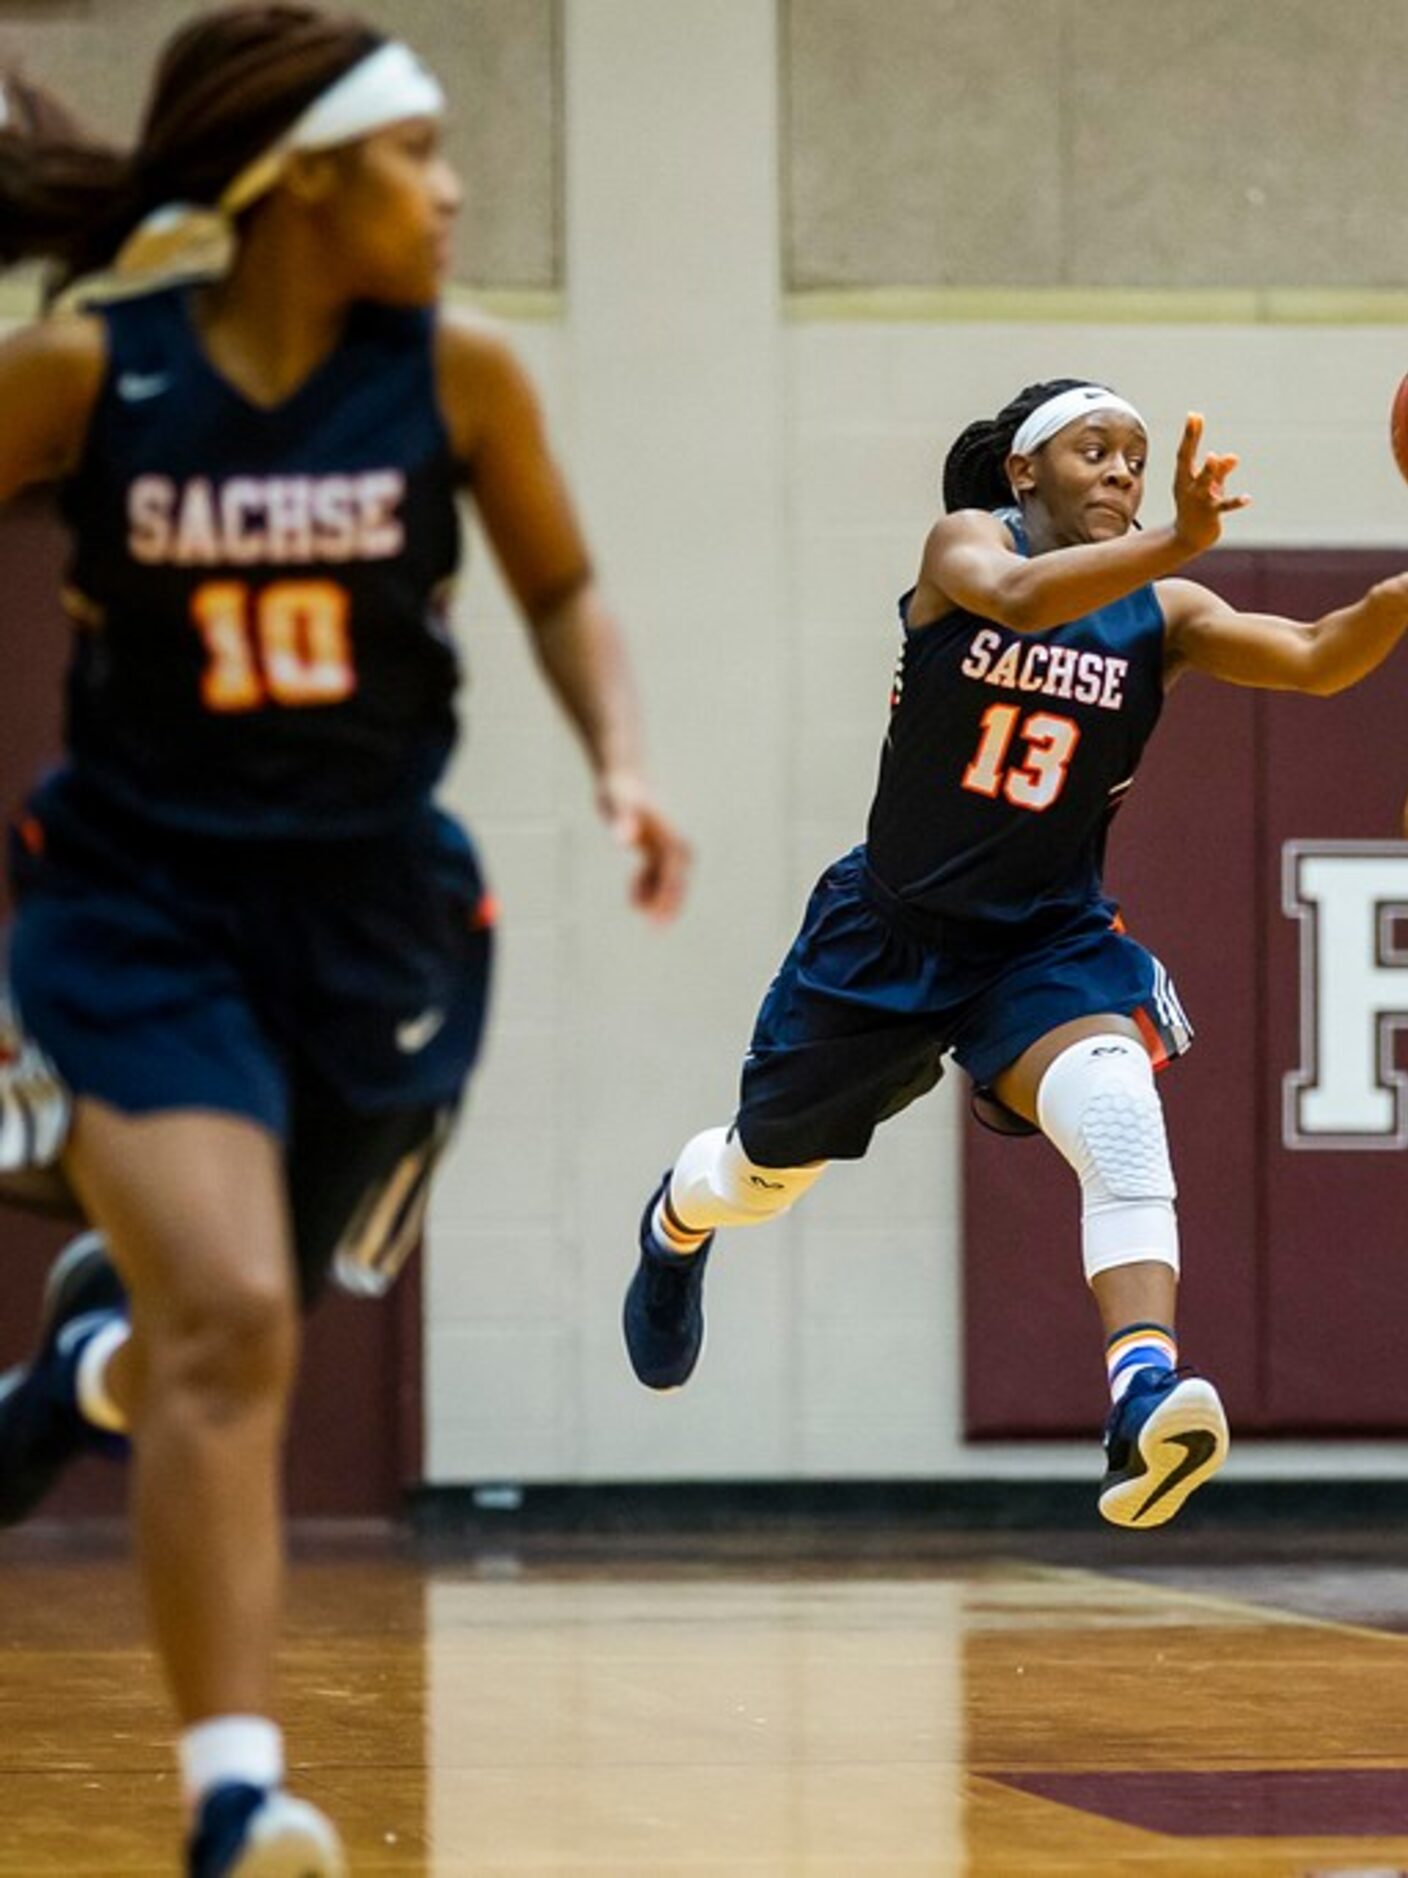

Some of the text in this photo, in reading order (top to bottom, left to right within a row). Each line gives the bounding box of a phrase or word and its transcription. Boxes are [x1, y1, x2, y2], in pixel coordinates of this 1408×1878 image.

[127, 470, 405, 565] SACHSE
[192, 579, 354, 712] 10
[961, 628, 1128, 710] SACHSE
[961, 702, 1081, 813] 13
